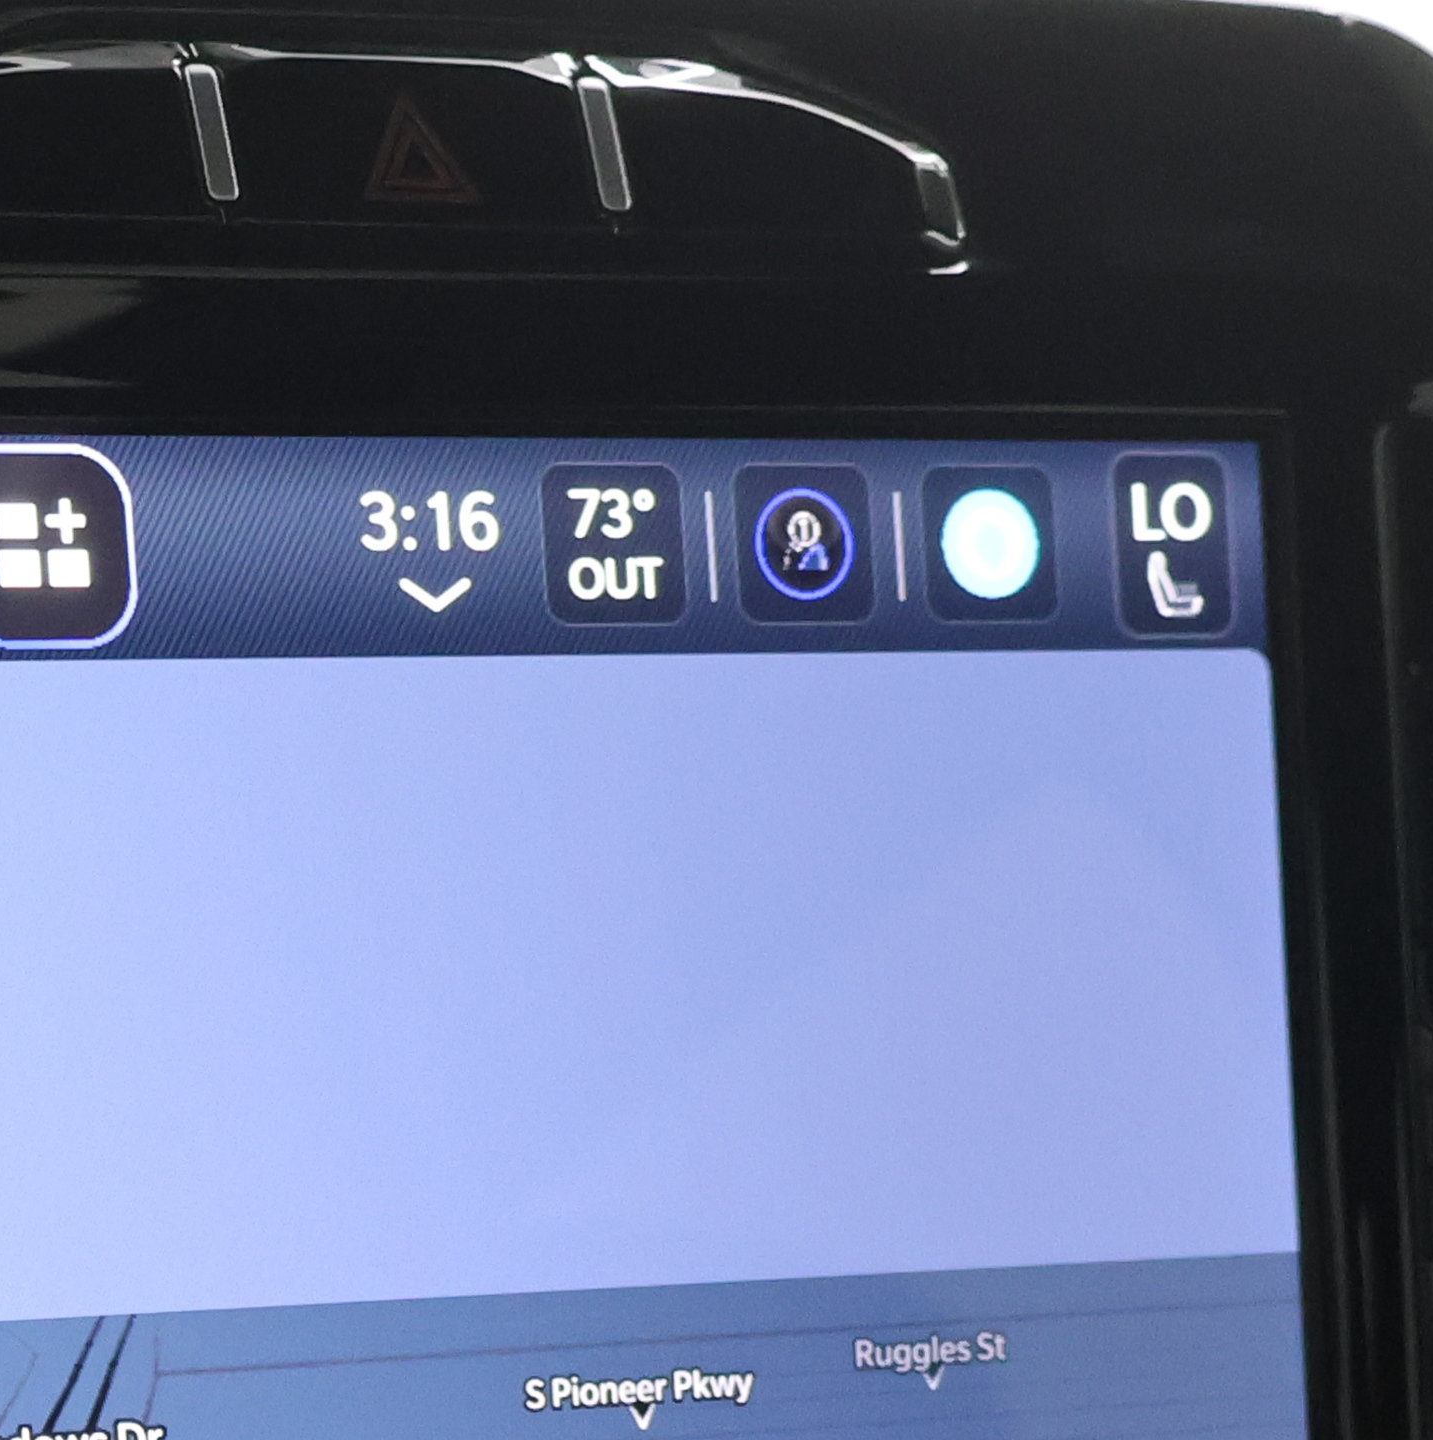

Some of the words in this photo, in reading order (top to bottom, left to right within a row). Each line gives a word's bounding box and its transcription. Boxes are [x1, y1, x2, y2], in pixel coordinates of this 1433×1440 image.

[358, 490, 500, 552] 3:16
[565, 487, 656, 541] 73°
[1131, 481, 1213, 542] LO
[568, 556, 664, 601] OUT
[854, 1336, 972, 1372] Ruggles
[976, 1332, 1007, 1363] St
[525, 1379, 547, 1411] S
[551, 1373, 667, 1409] Pioneer
[673, 1368, 755, 1405] Pkwy
